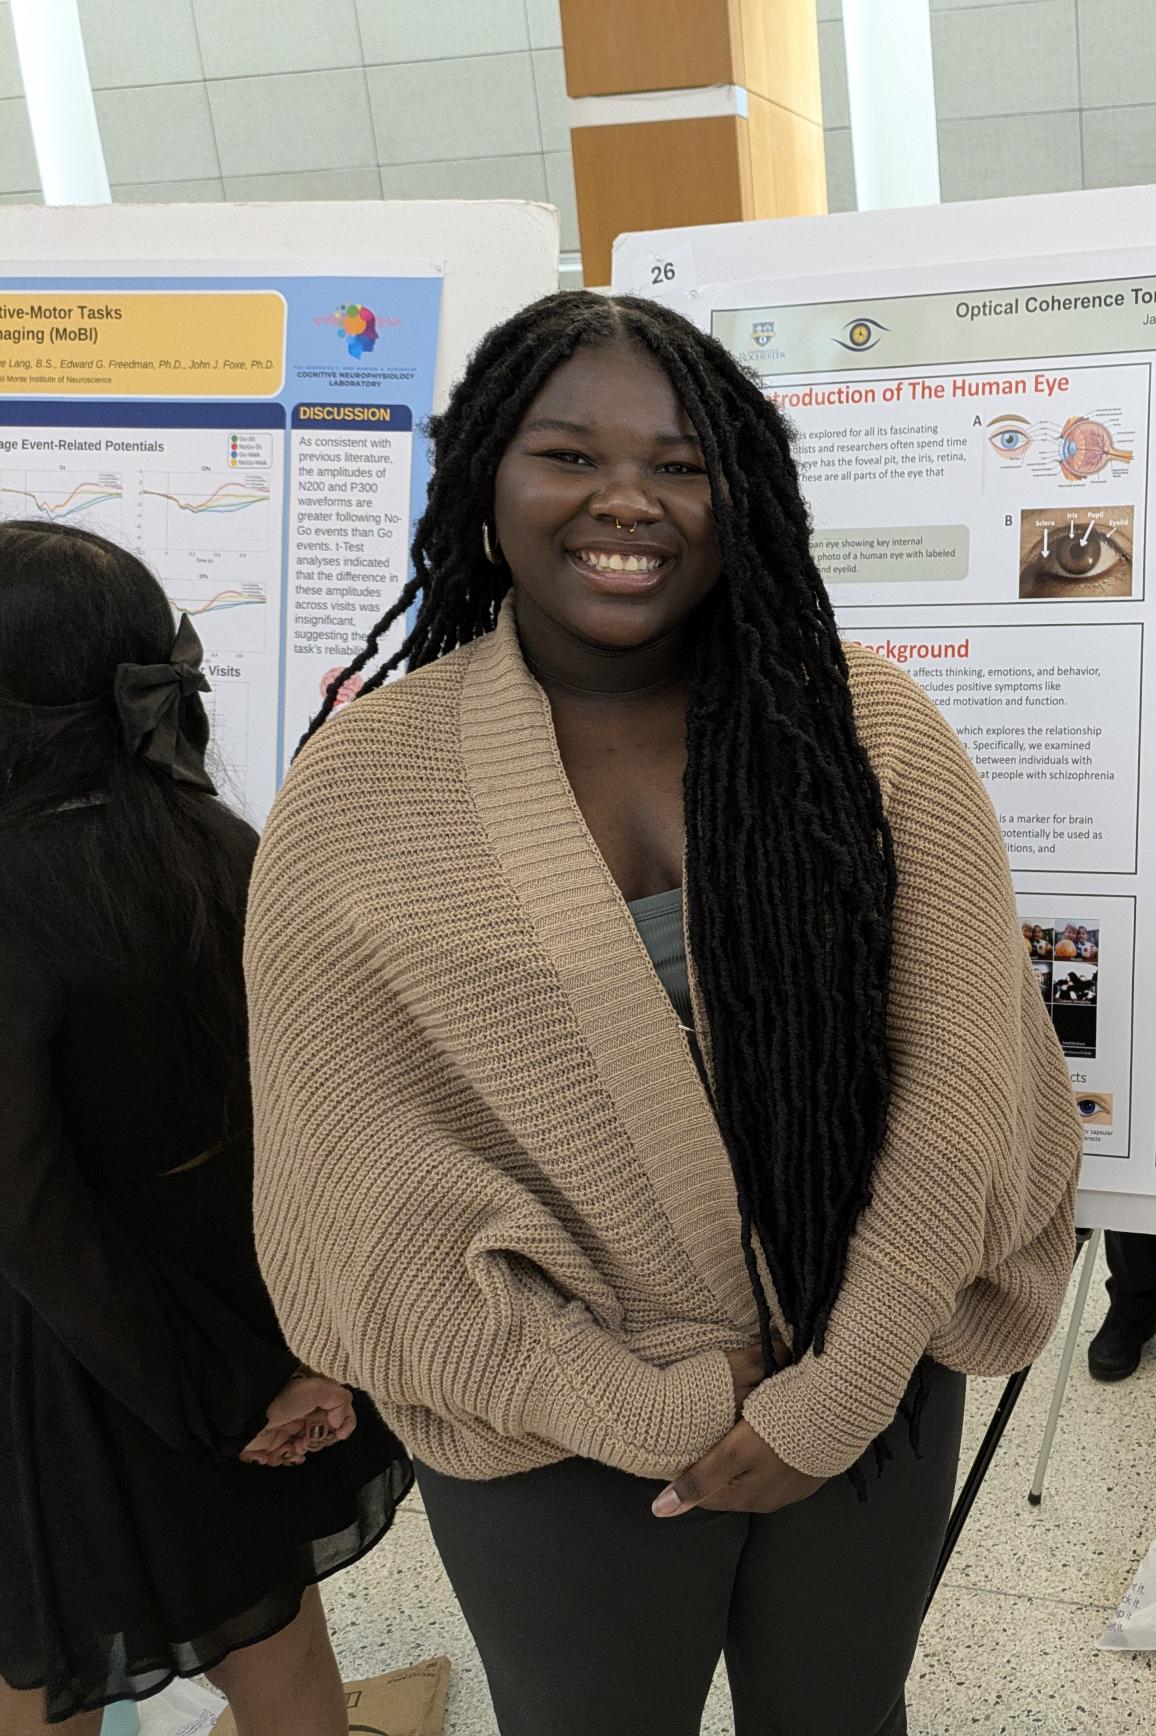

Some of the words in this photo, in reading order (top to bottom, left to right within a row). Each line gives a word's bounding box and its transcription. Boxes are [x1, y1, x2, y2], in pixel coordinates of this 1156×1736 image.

[650, 262, 675, 284] 26
[0, 303, 73, 322] tive-Motor
[76, 304, 121, 319] Tasks
[955, 297, 1018, 321] Optical
[1025, 293, 1124, 312] Coherence
[6, 374, 27, 382] Monte
[29, 375, 56, 383] Institute
[57, 375, 64, 383] of
[66, 375, 112, 383] Neuroscience
[338, 371, 414, 379] NEUROPHYSIOLOGY
[328, 379, 381, 387] LABORATORY
[767, 385, 876, 410] troduction
[882, 382, 903, 402] of
[908, 380, 945, 401] The
[952, 377, 1027, 399] Human
[1034, 373, 1070, 397] Eye
[299, 406, 390, 421] DISCUSSION
[972, 415, 982, 426] A
[809, 427, 847, 441] explored
[849, 427, 862, 437] for
[863, 426, 874, 436] all
[876, 426, 887, 436] its
[889, 423, 938, 435] fascinating
[0, 437, 18, 453] age
[21, 438, 101, 450] Event-Related
[105, 439, 164, 452] Potentials
[298, 436, 312, 446] As
[314, 438, 367, 447] consistent
[369, 437, 391, 448] with
[298, 480, 325, 491] N200
[327, 481, 347, 492] and
[349, 482, 378, 493] P300
[297, 512, 333, 523] greater
[335, 510, 381, 525] following
[384, 512, 402, 523] No-
[1004, 514, 1012, 526] B
[294, 613, 356, 627] insignificant,
[208, 665, 241, 677] Visits
[956, 724, 983, 737] which
[985, 725, 1025, 737] explores
[1027, 725, 1043, 735] the
[1045, 725, 1101, 737] relationship
